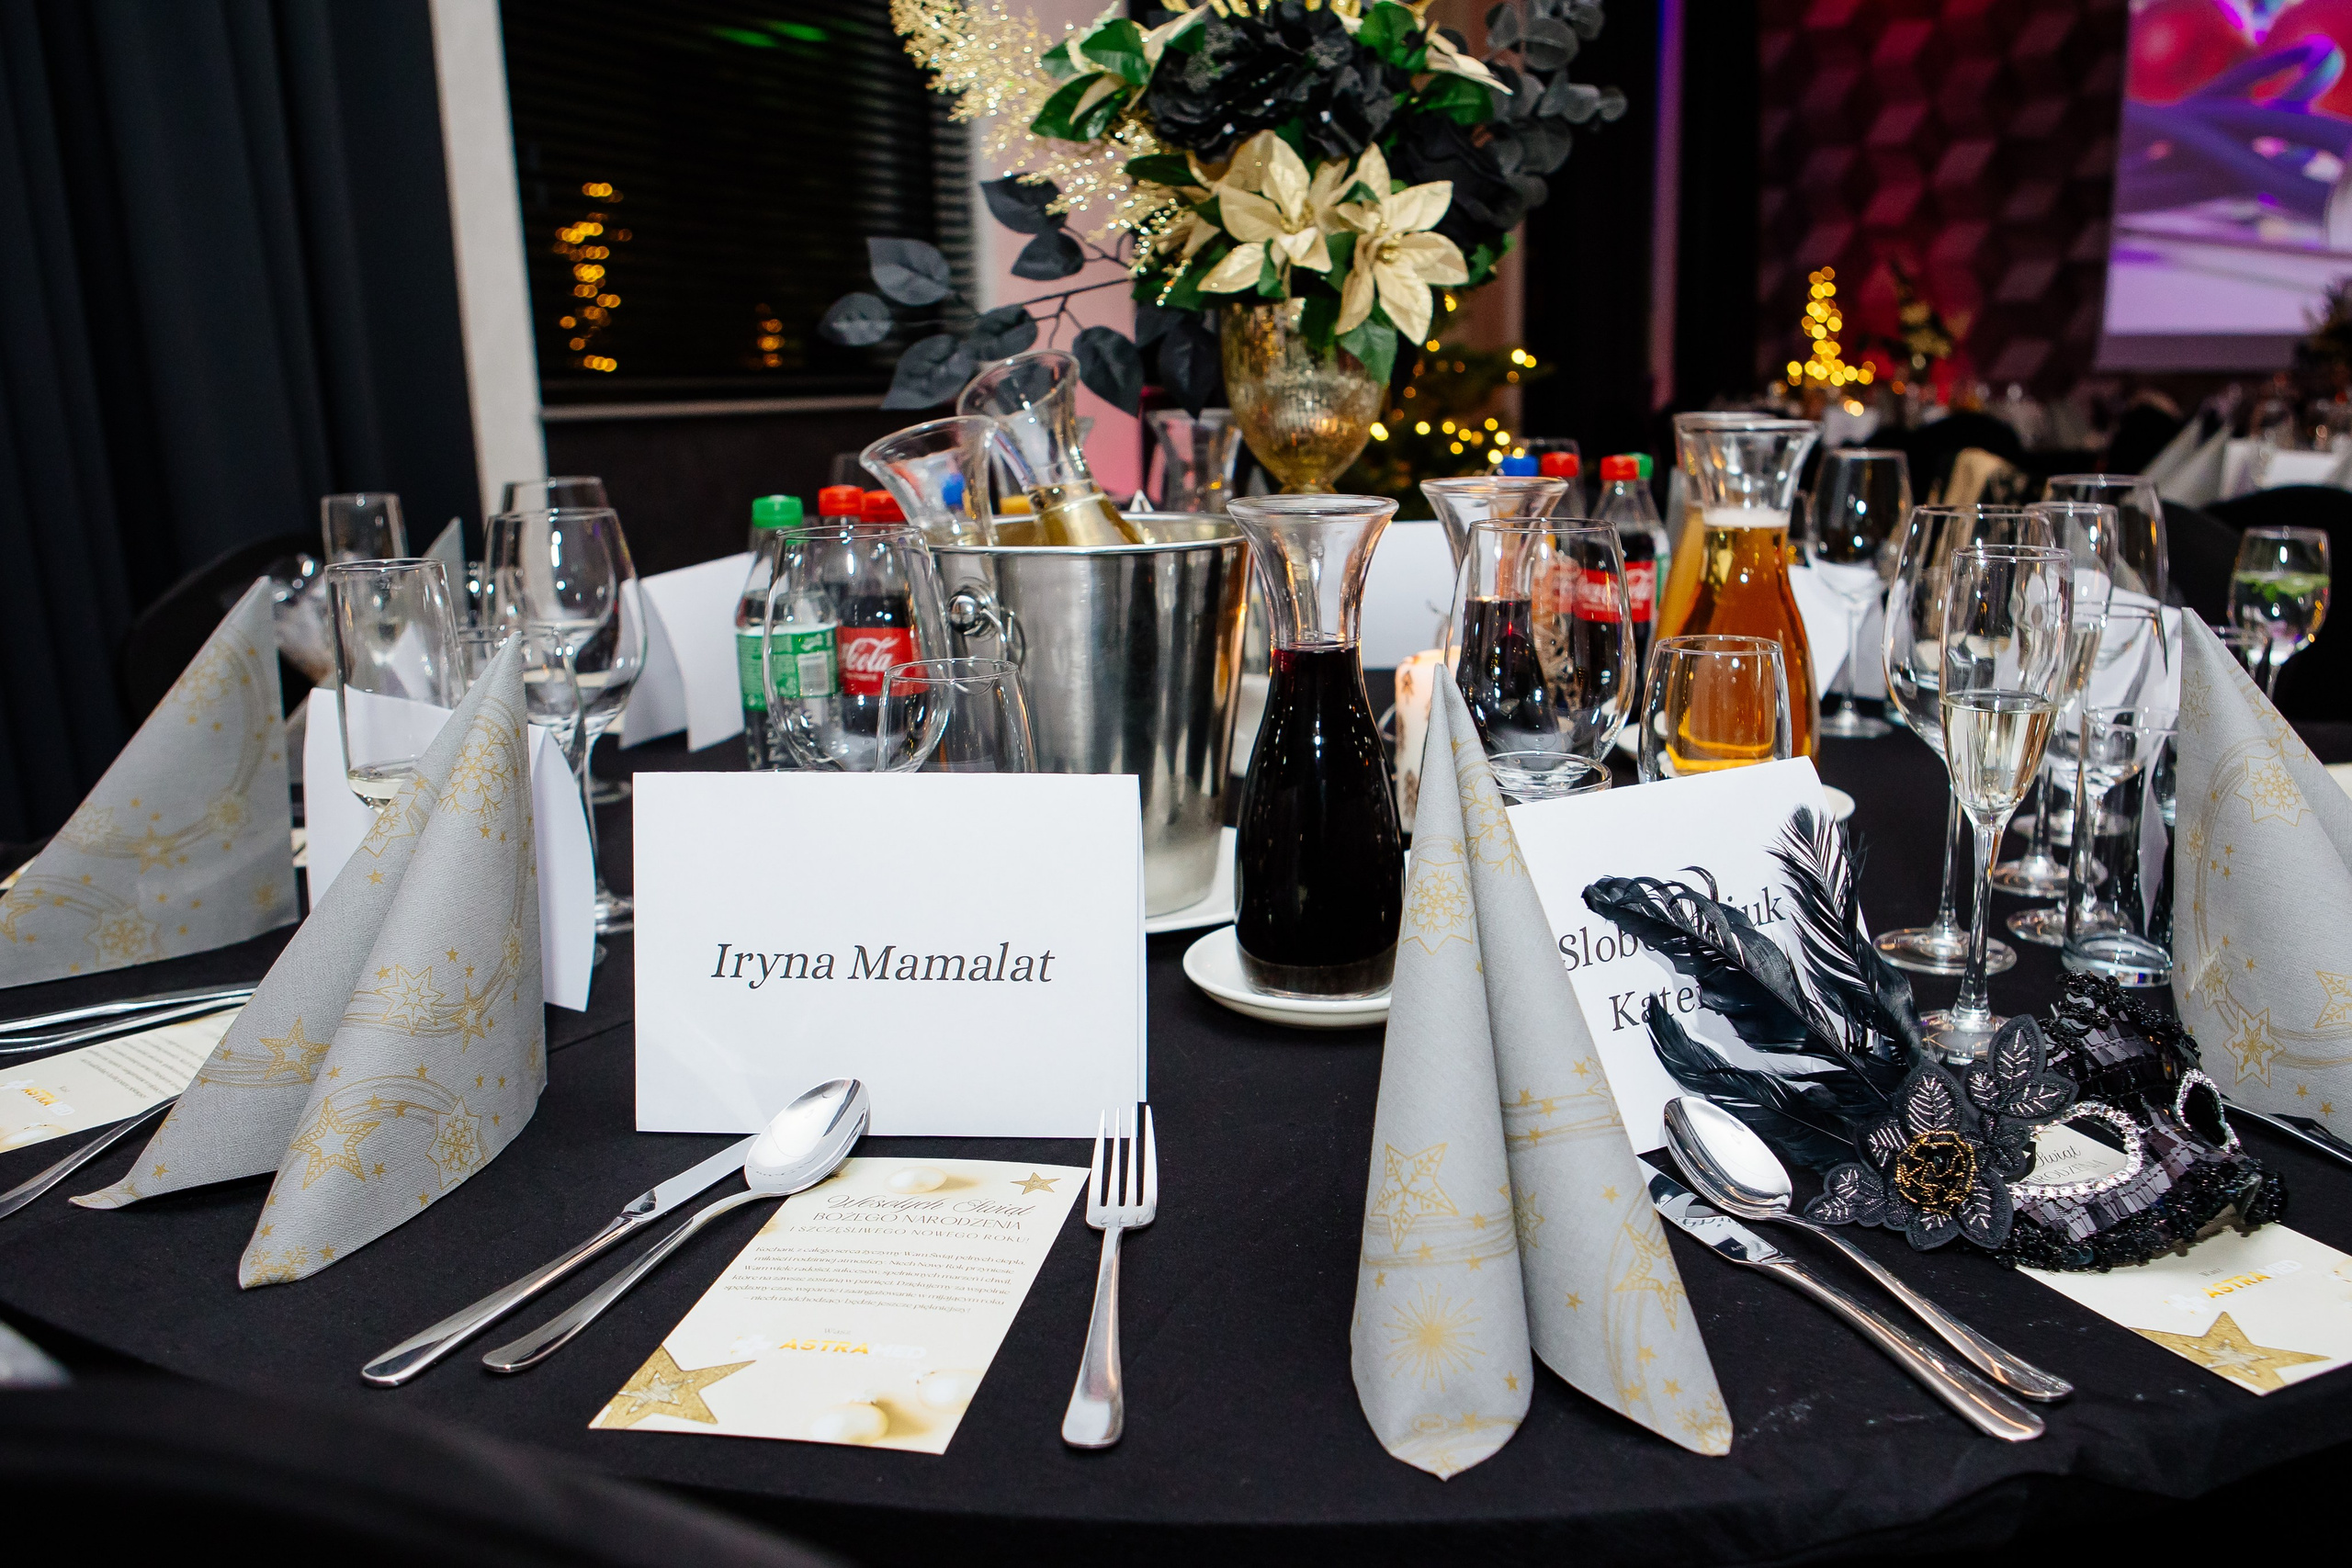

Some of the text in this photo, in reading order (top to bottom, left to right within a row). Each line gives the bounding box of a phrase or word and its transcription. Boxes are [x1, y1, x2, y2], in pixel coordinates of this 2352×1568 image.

[710, 942, 1056, 989] Iryna Mamalat
[827, 1194, 1036, 1217] Wesołych Świąt
[813, 1212, 1022, 1230] BOŻEGO NARODZENIA
[910, 1229, 979, 1239] NOWEGO
[983, 1234, 1030, 1244] ROKU!
[778, 1339, 927, 1359] ASTRAMED
